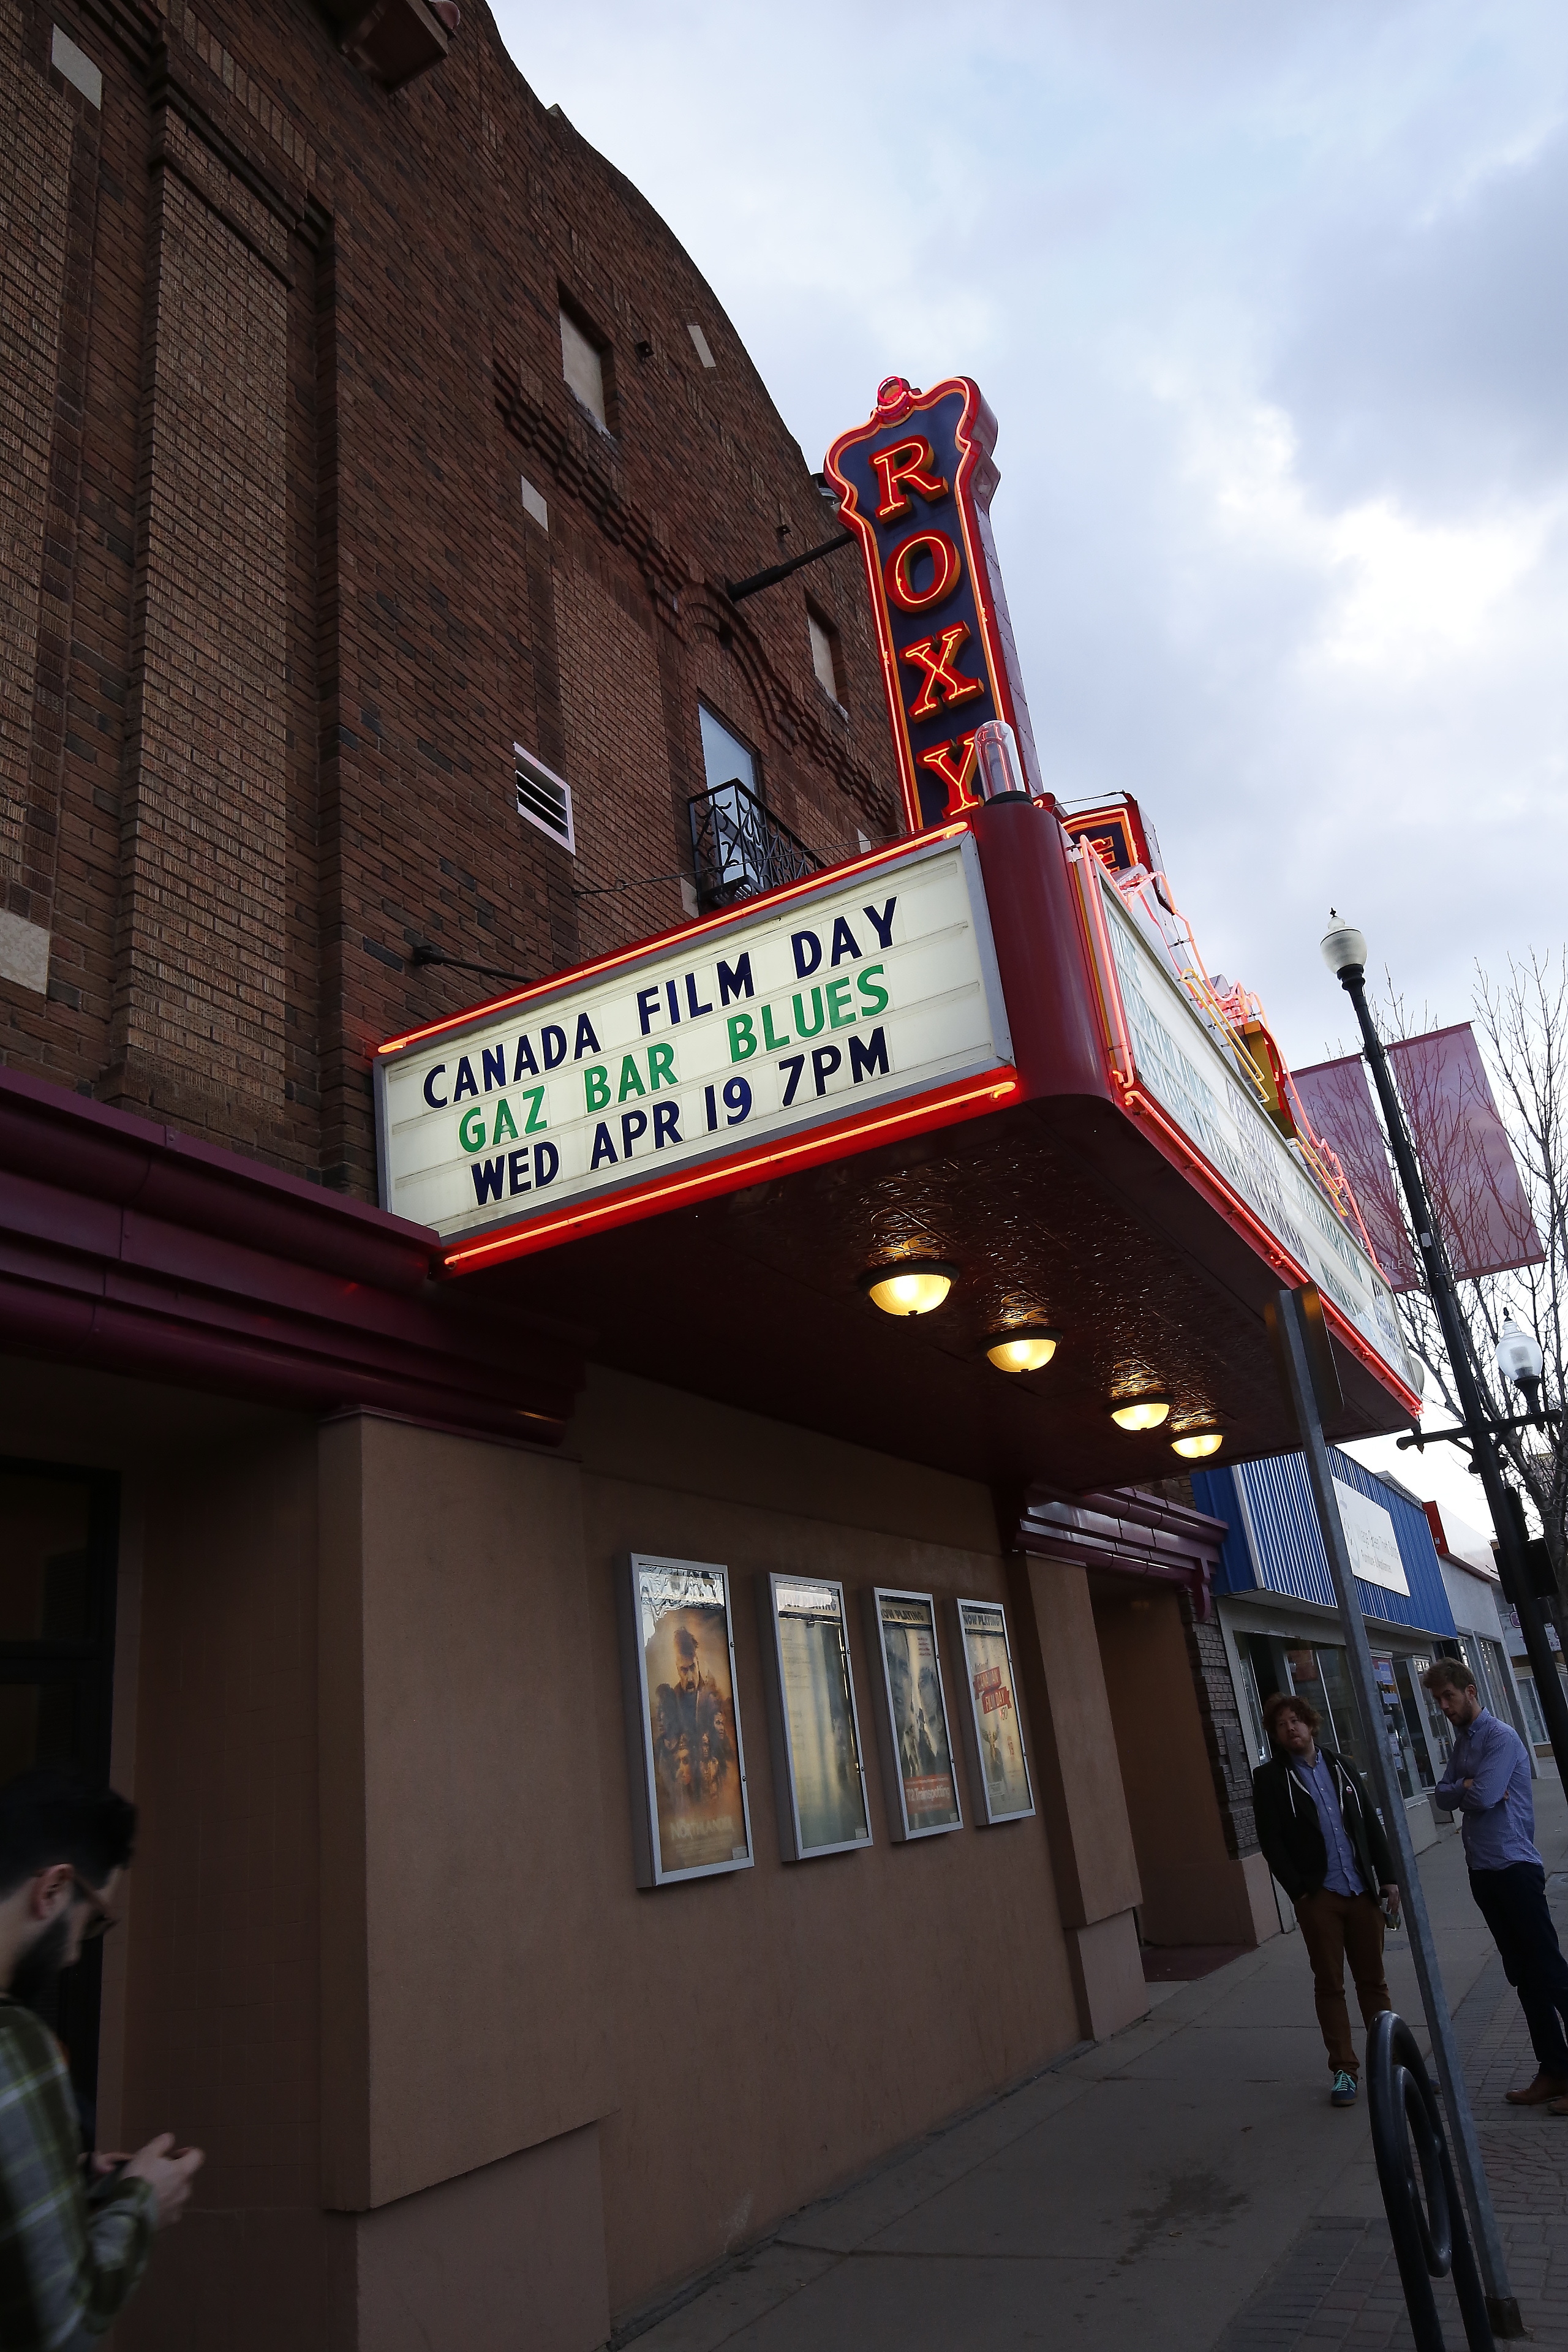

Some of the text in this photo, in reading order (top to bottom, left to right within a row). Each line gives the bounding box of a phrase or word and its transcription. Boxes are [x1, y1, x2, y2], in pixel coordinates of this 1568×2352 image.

[868, 435, 984, 821] ROXY
[423, 895, 897, 1109] CANADA FILM DAY
[458, 963, 889, 1153] GAZ BAR BLUES
[470, 1026, 890, 1206] WED APR 19 7PM
